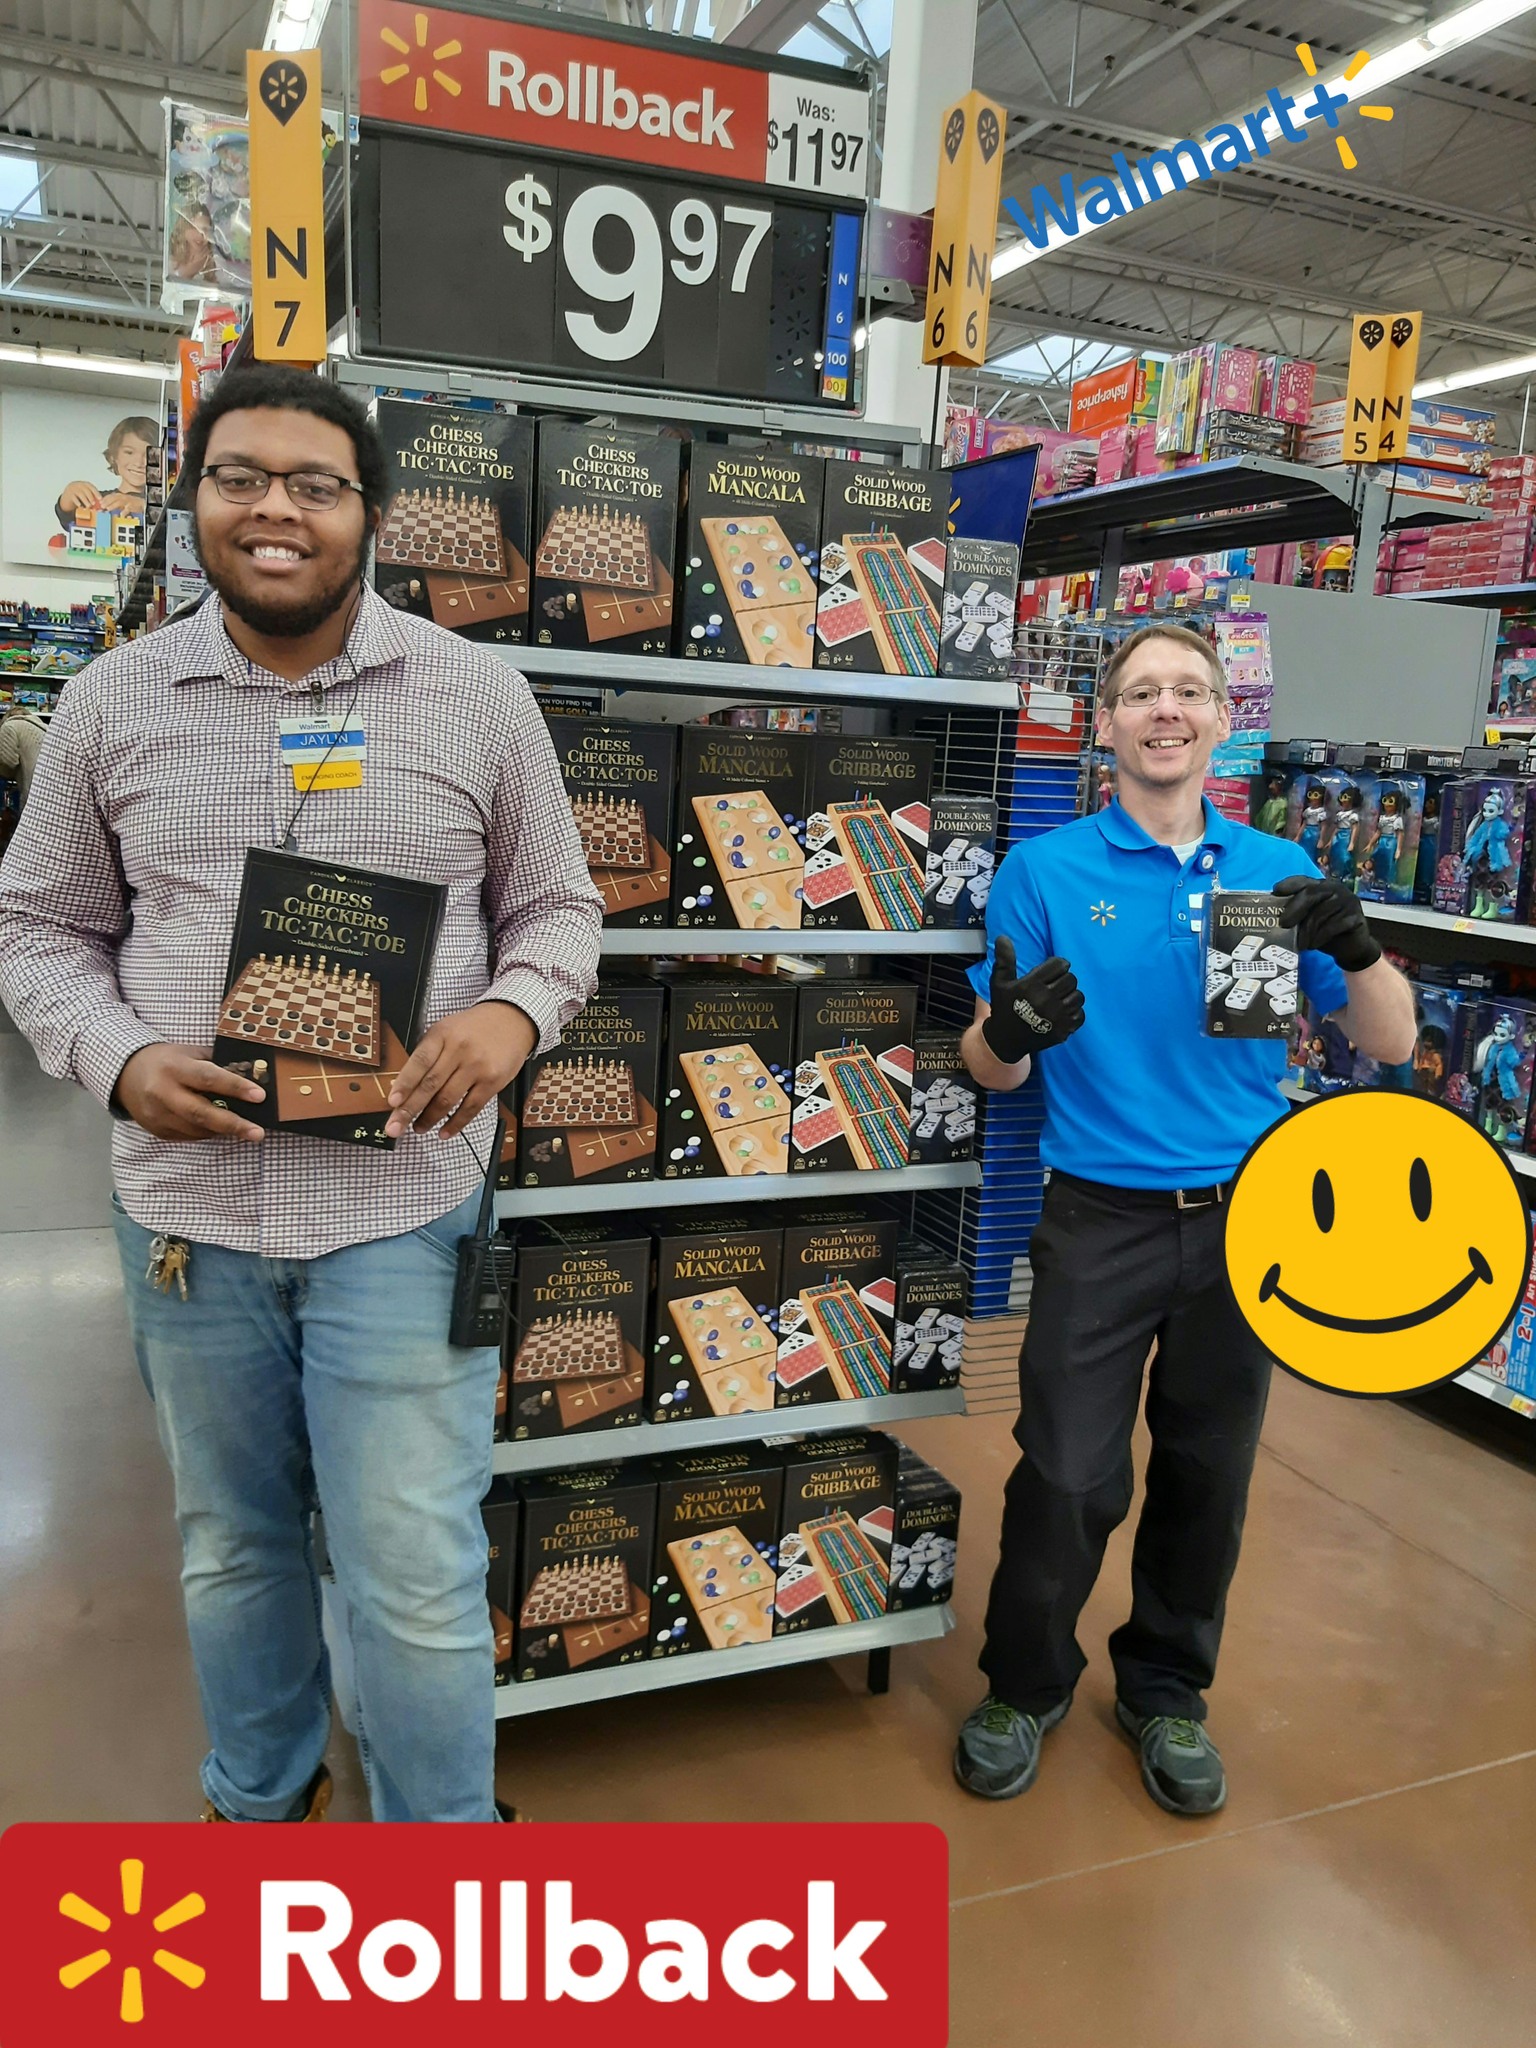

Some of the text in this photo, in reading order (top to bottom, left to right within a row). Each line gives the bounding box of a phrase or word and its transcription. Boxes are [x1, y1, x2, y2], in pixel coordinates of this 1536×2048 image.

[488, 50, 735, 150] Rollback
[797, 96, 835, 122] Was:
[267, 227, 306, 279] N
[934, 243, 954, 294] N
[967, 243, 988, 296] N
[838, 273, 848, 286] N
[273, 300, 297, 347] 7
[836, 312, 844, 324] 6
[932, 307, 945, 349] 6
[966, 310, 977, 349] 6
[827, 352, 847, 366] 100
[1353, 398, 1376, 423] N
[1382, 395, 1404, 421] N
[430, 424, 483, 444] CHESS
[1354, 432, 1367, 455] 5
[1379, 430, 1395, 453] 4
[413, 437, 498, 461] CHECKERS
[588, 444, 636, 464] CHESS
[573, 456, 649, 480] CHECKERS
[717, 460, 800, 483] SOLID WOOD
[707, 473, 806, 504] MANCALA
[854, 474, 926, 494] SOLID WOOD
[844, 486, 932, 512] CRIBBAGE
[953, 560, 1012, 577] DOMINOES
[299, 722, 331, 730] Walmart
[582, 737, 631, 752] CHESS
[707, 742, 789, 760] SOLID WOOD
[838, 747, 910, 762] SOLID WOOD
[567, 750, 644, 766] CHECKERS
[699, 755, 793, 777] MANCALA
[829, 759, 917, 779] CRIBBAGE
[934, 820, 992, 832] DOMINOES
[306, 883, 373, 911] CHESS
[284, 896, 389, 931] CHECKERS
[694, 1000, 773, 1014] SOLID WOOD
[825, 997, 894, 1008] SOLID WOOD
[685, 1013, 779, 1031] MANCALA
[816, 1008, 900, 1024] CRIBBAGE
[354, 1129, 368, 1139] 8+
[809, 1234, 876, 1247] SOLID WOOD
[683, 1245, 761, 1261] SOLID WOOD
[800, 1245, 882, 1264] CRIBBAGE
[562, 1259, 608, 1273] CHESS
[674, 1258, 766, 1279] MANCALA
[547, 1270, 620, 1287] CHECKERS
[906, 1290, 962, 1304] DOMINOES
[810, 1465, 876, 1483] SOLID WOOD
[682, 1485, 761, 1505] SOLID WOOD
[801, 1475, 881, 1499] CRIBBAGE
[569, 1506, 614, 1521] CHESS
[674, 1497, 767, 1522] MANCALA
[555, 1516, 627, 1536] CHECKERS
